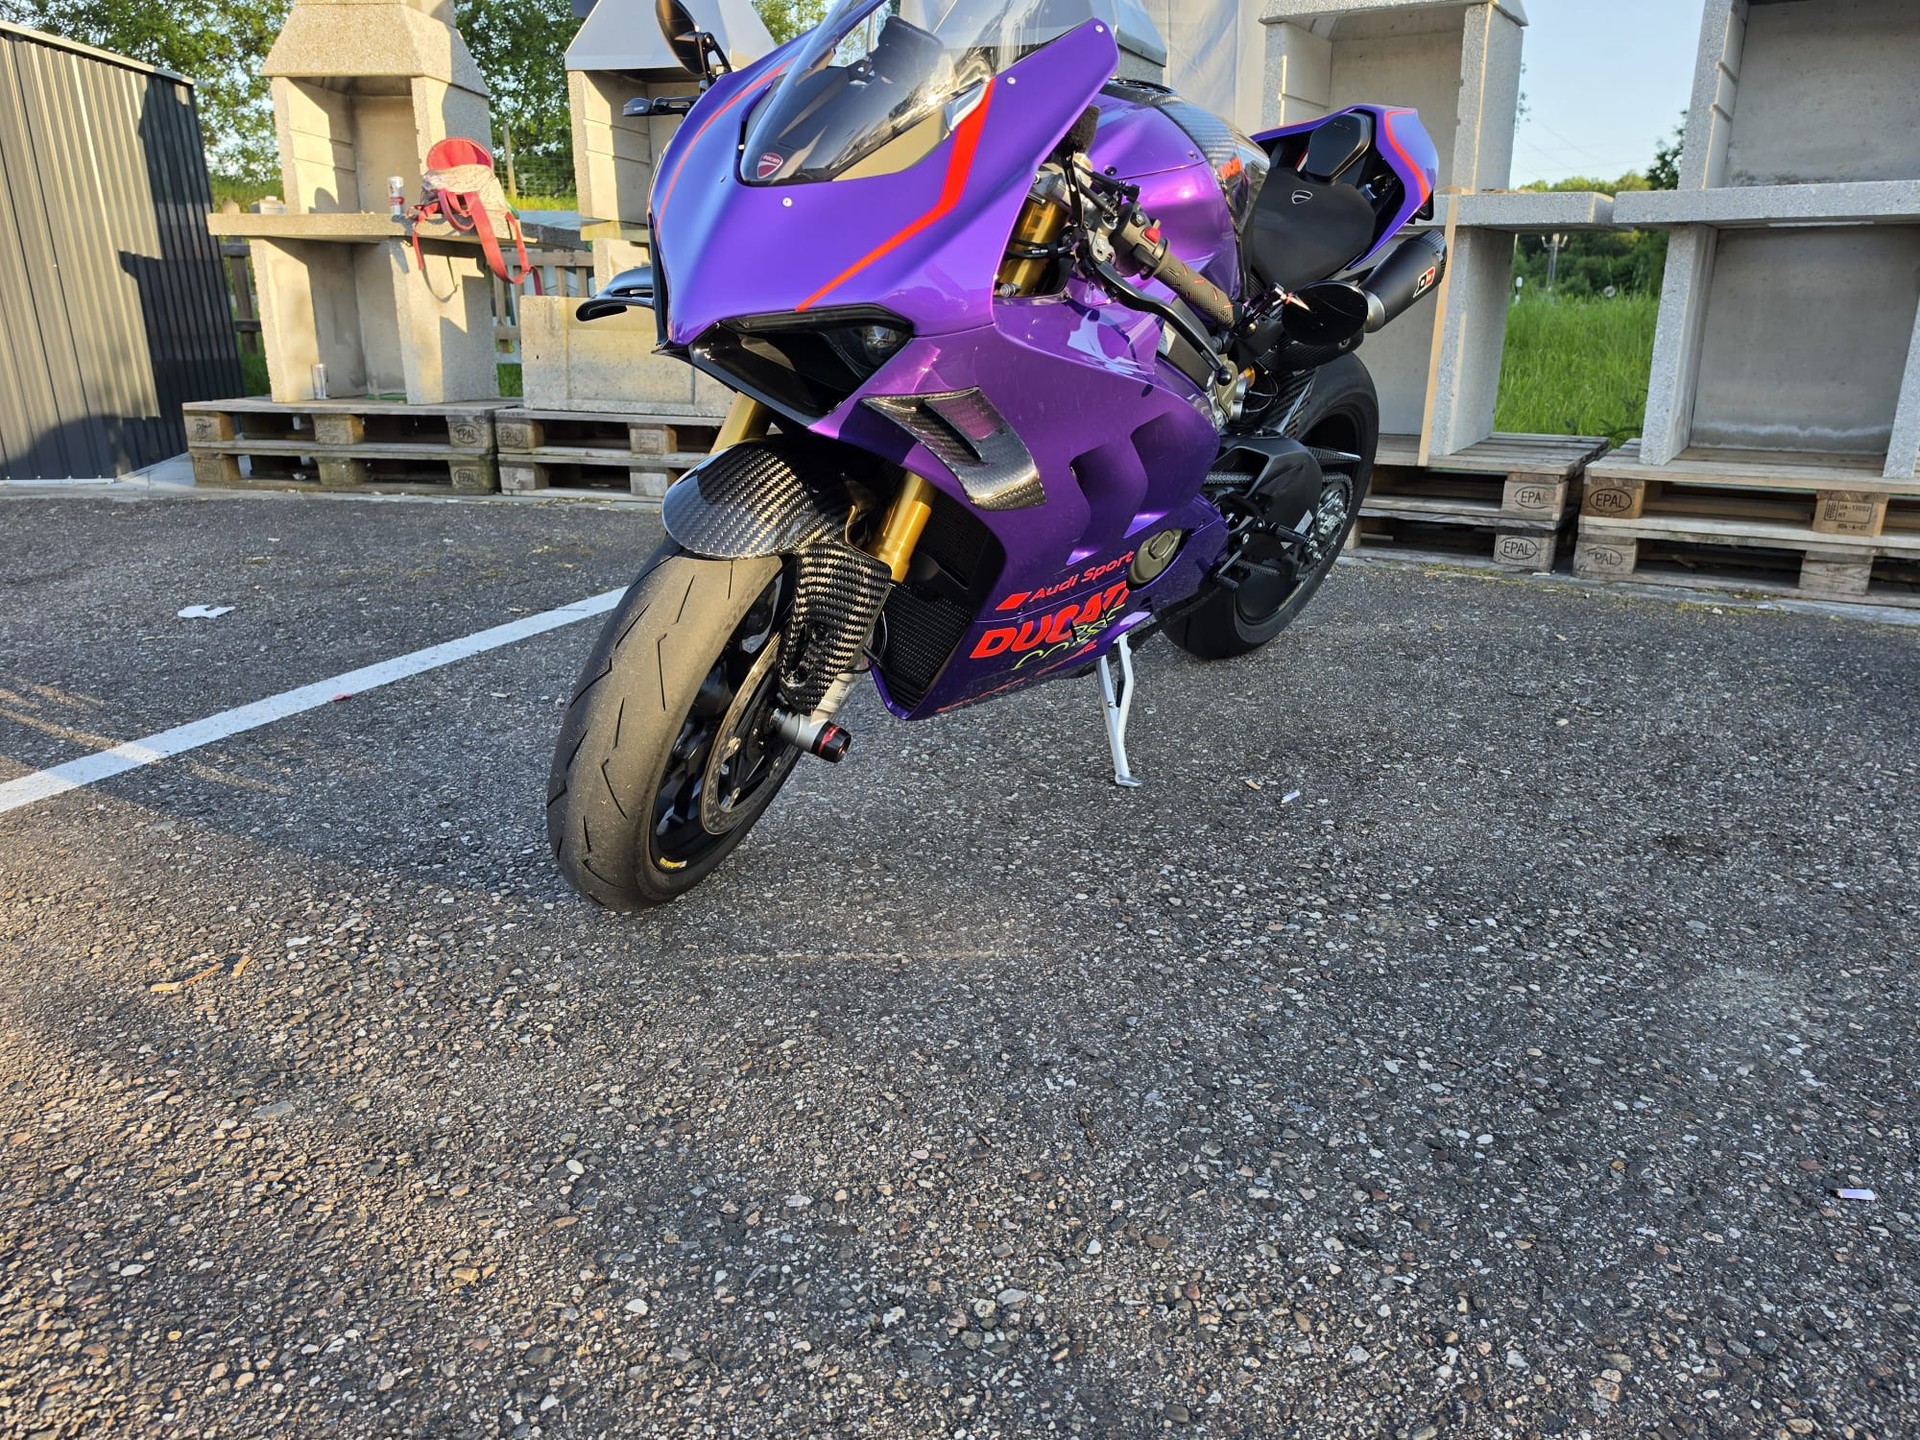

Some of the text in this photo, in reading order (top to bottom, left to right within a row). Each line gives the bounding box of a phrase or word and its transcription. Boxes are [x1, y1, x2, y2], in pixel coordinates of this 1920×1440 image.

[1595, 493, 1625, 509] EPAL
[1503, 540, 1531, 556] EPAL
[1029, 550, 1135, 602] Audi Sport
[969, 580, 1130, 659] DUCATI
